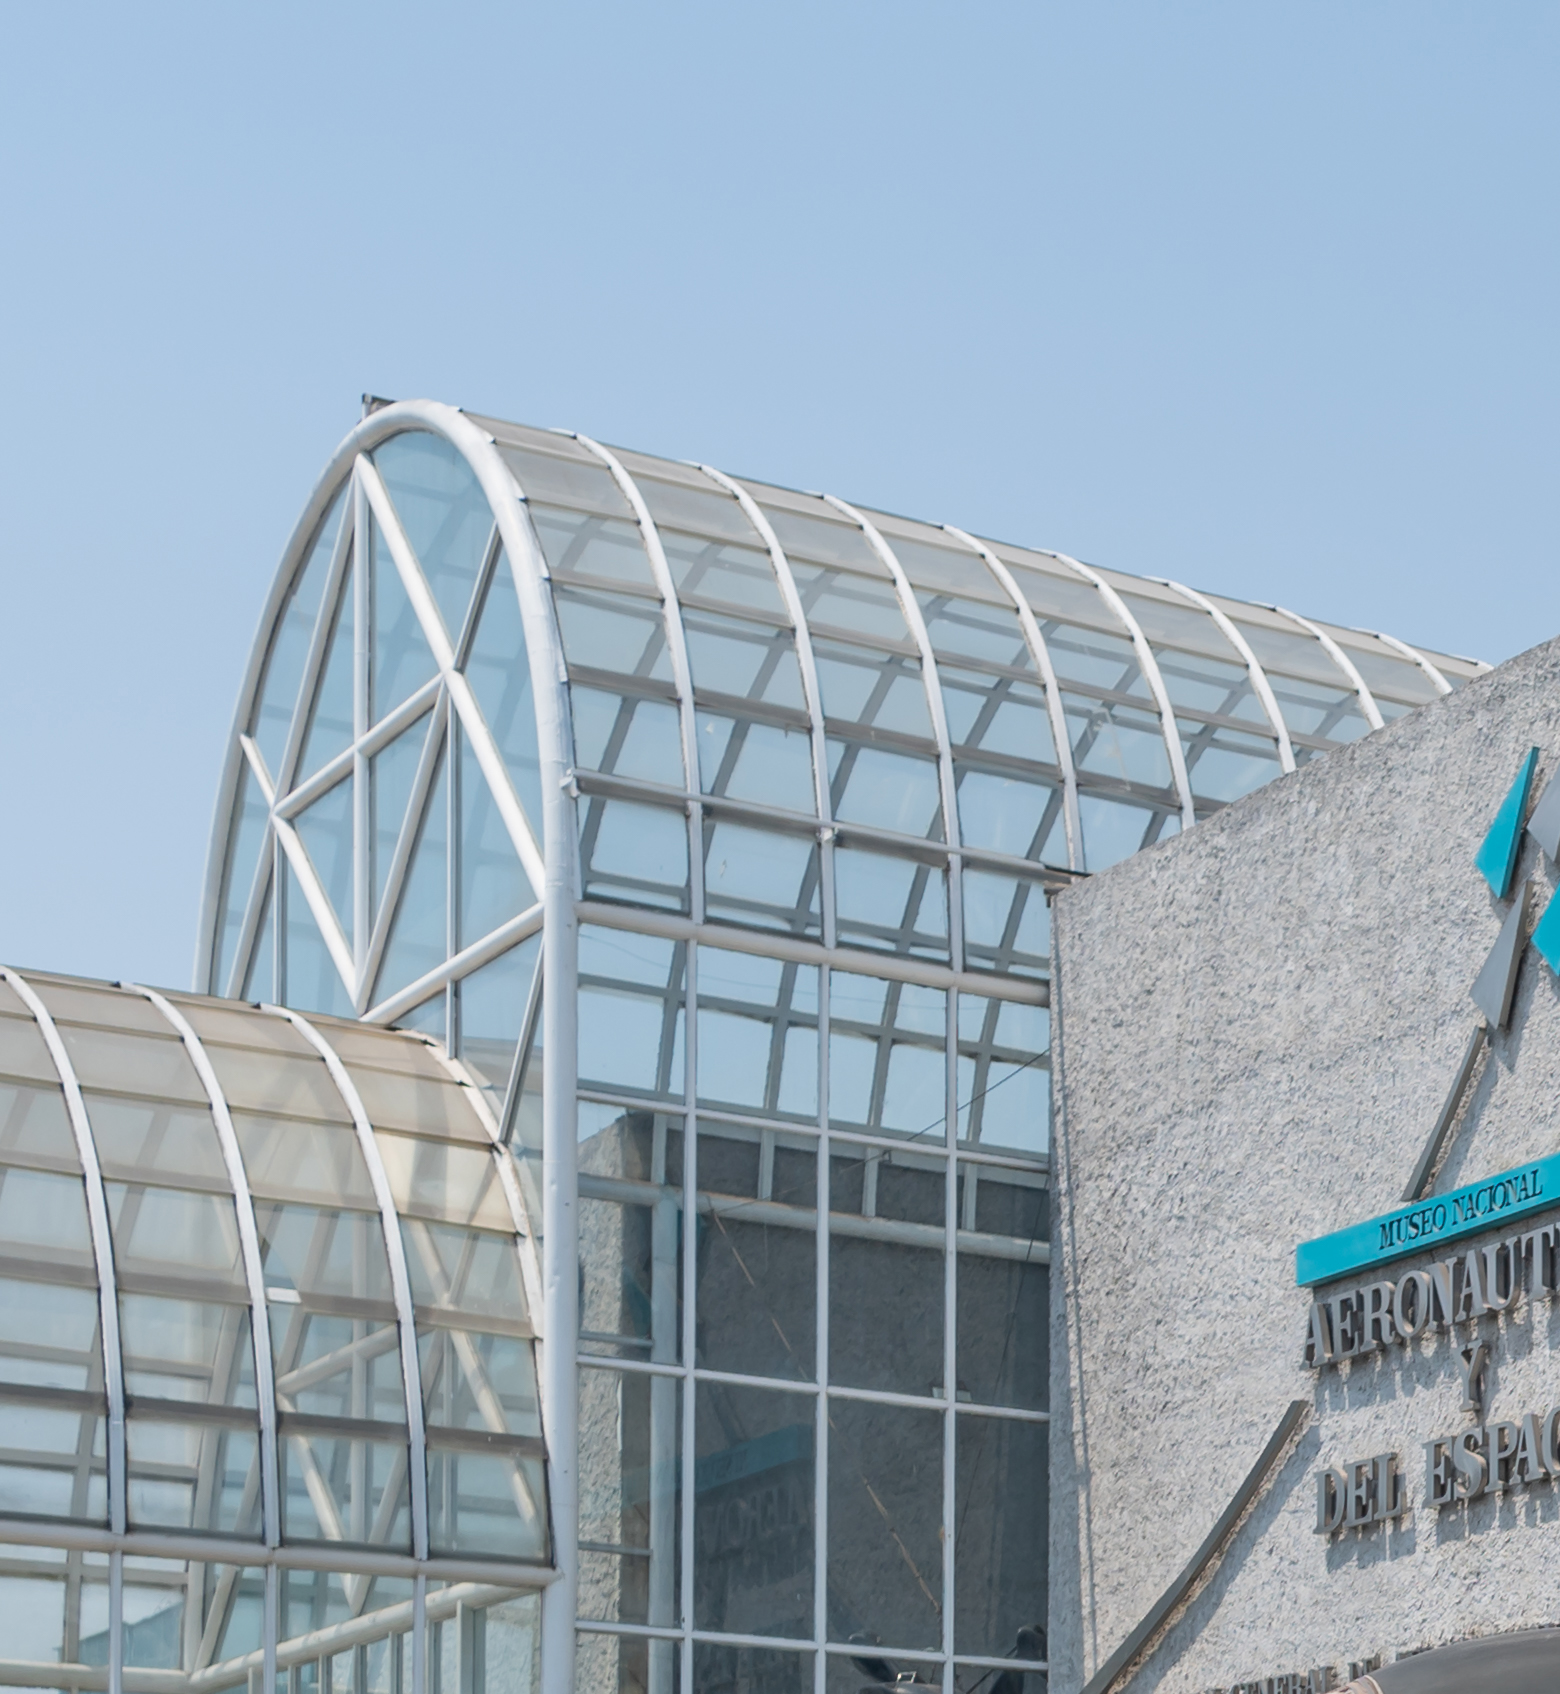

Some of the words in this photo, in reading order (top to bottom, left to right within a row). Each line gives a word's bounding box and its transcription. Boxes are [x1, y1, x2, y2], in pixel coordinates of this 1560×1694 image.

[1379, 1204, 1446, 1250] MUSEO
[1452, 1169, 1543, 1225] NACIONAL
[1455, 1339, 1486, 1413] Y
[1313, 1452, 1407, 1535] DEL
